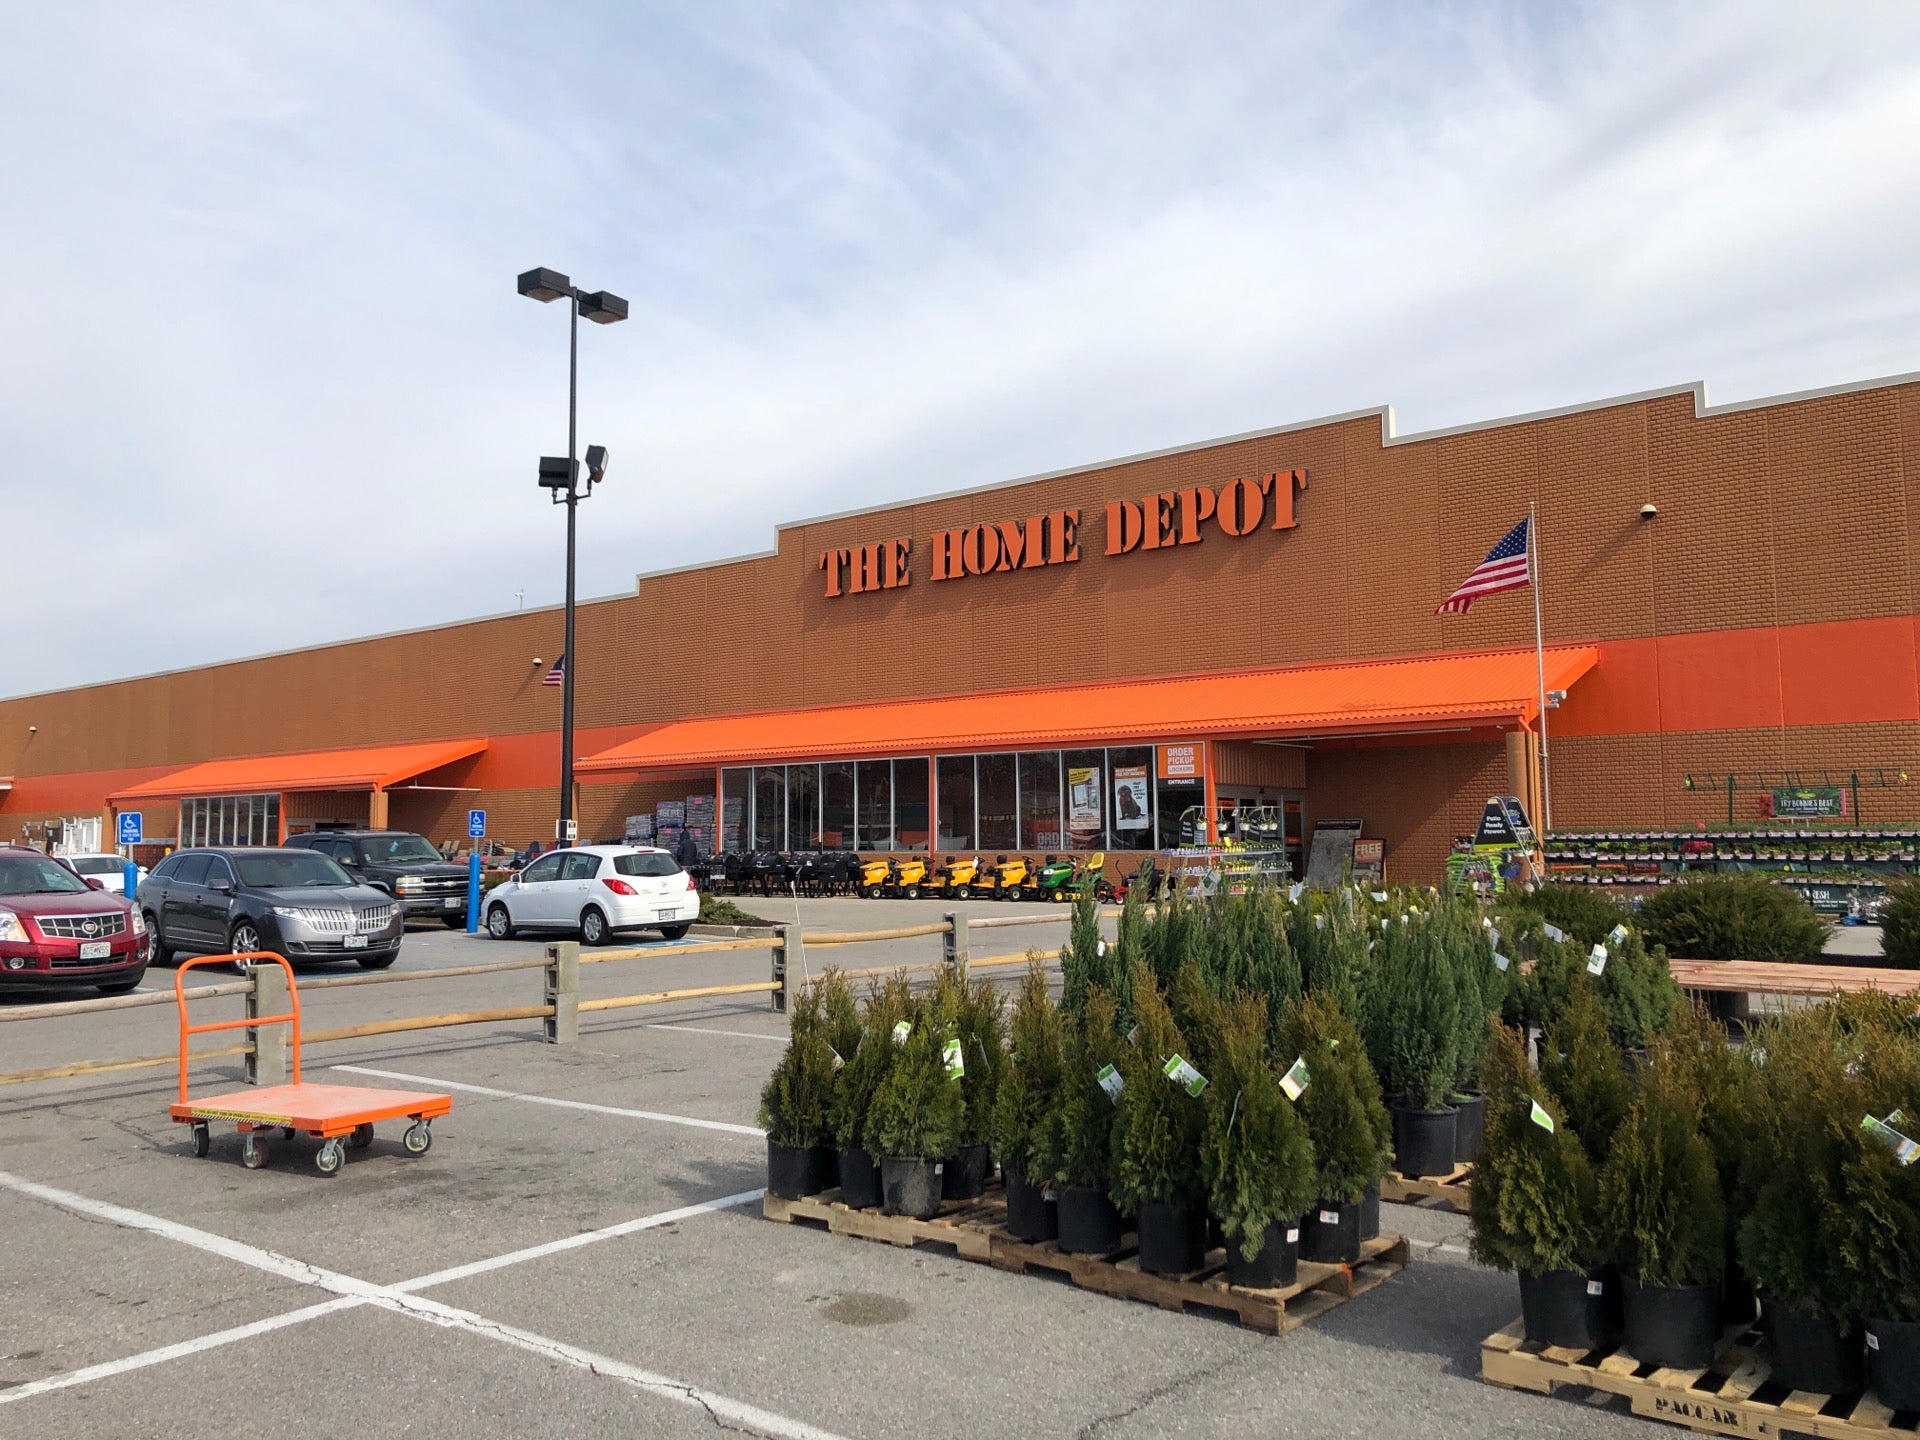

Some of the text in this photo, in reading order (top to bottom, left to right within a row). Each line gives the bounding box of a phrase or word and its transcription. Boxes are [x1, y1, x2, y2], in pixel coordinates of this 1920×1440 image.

[819, 468, 1307, 597] THE HOME DEPOT
[1167, 747, 1194, 757] ORDER
[1167, 755, 1194, 765] PICKUP
[1037, 831, 1073, 845] ORDR
[1354, 842, 1382, 856] FREE
